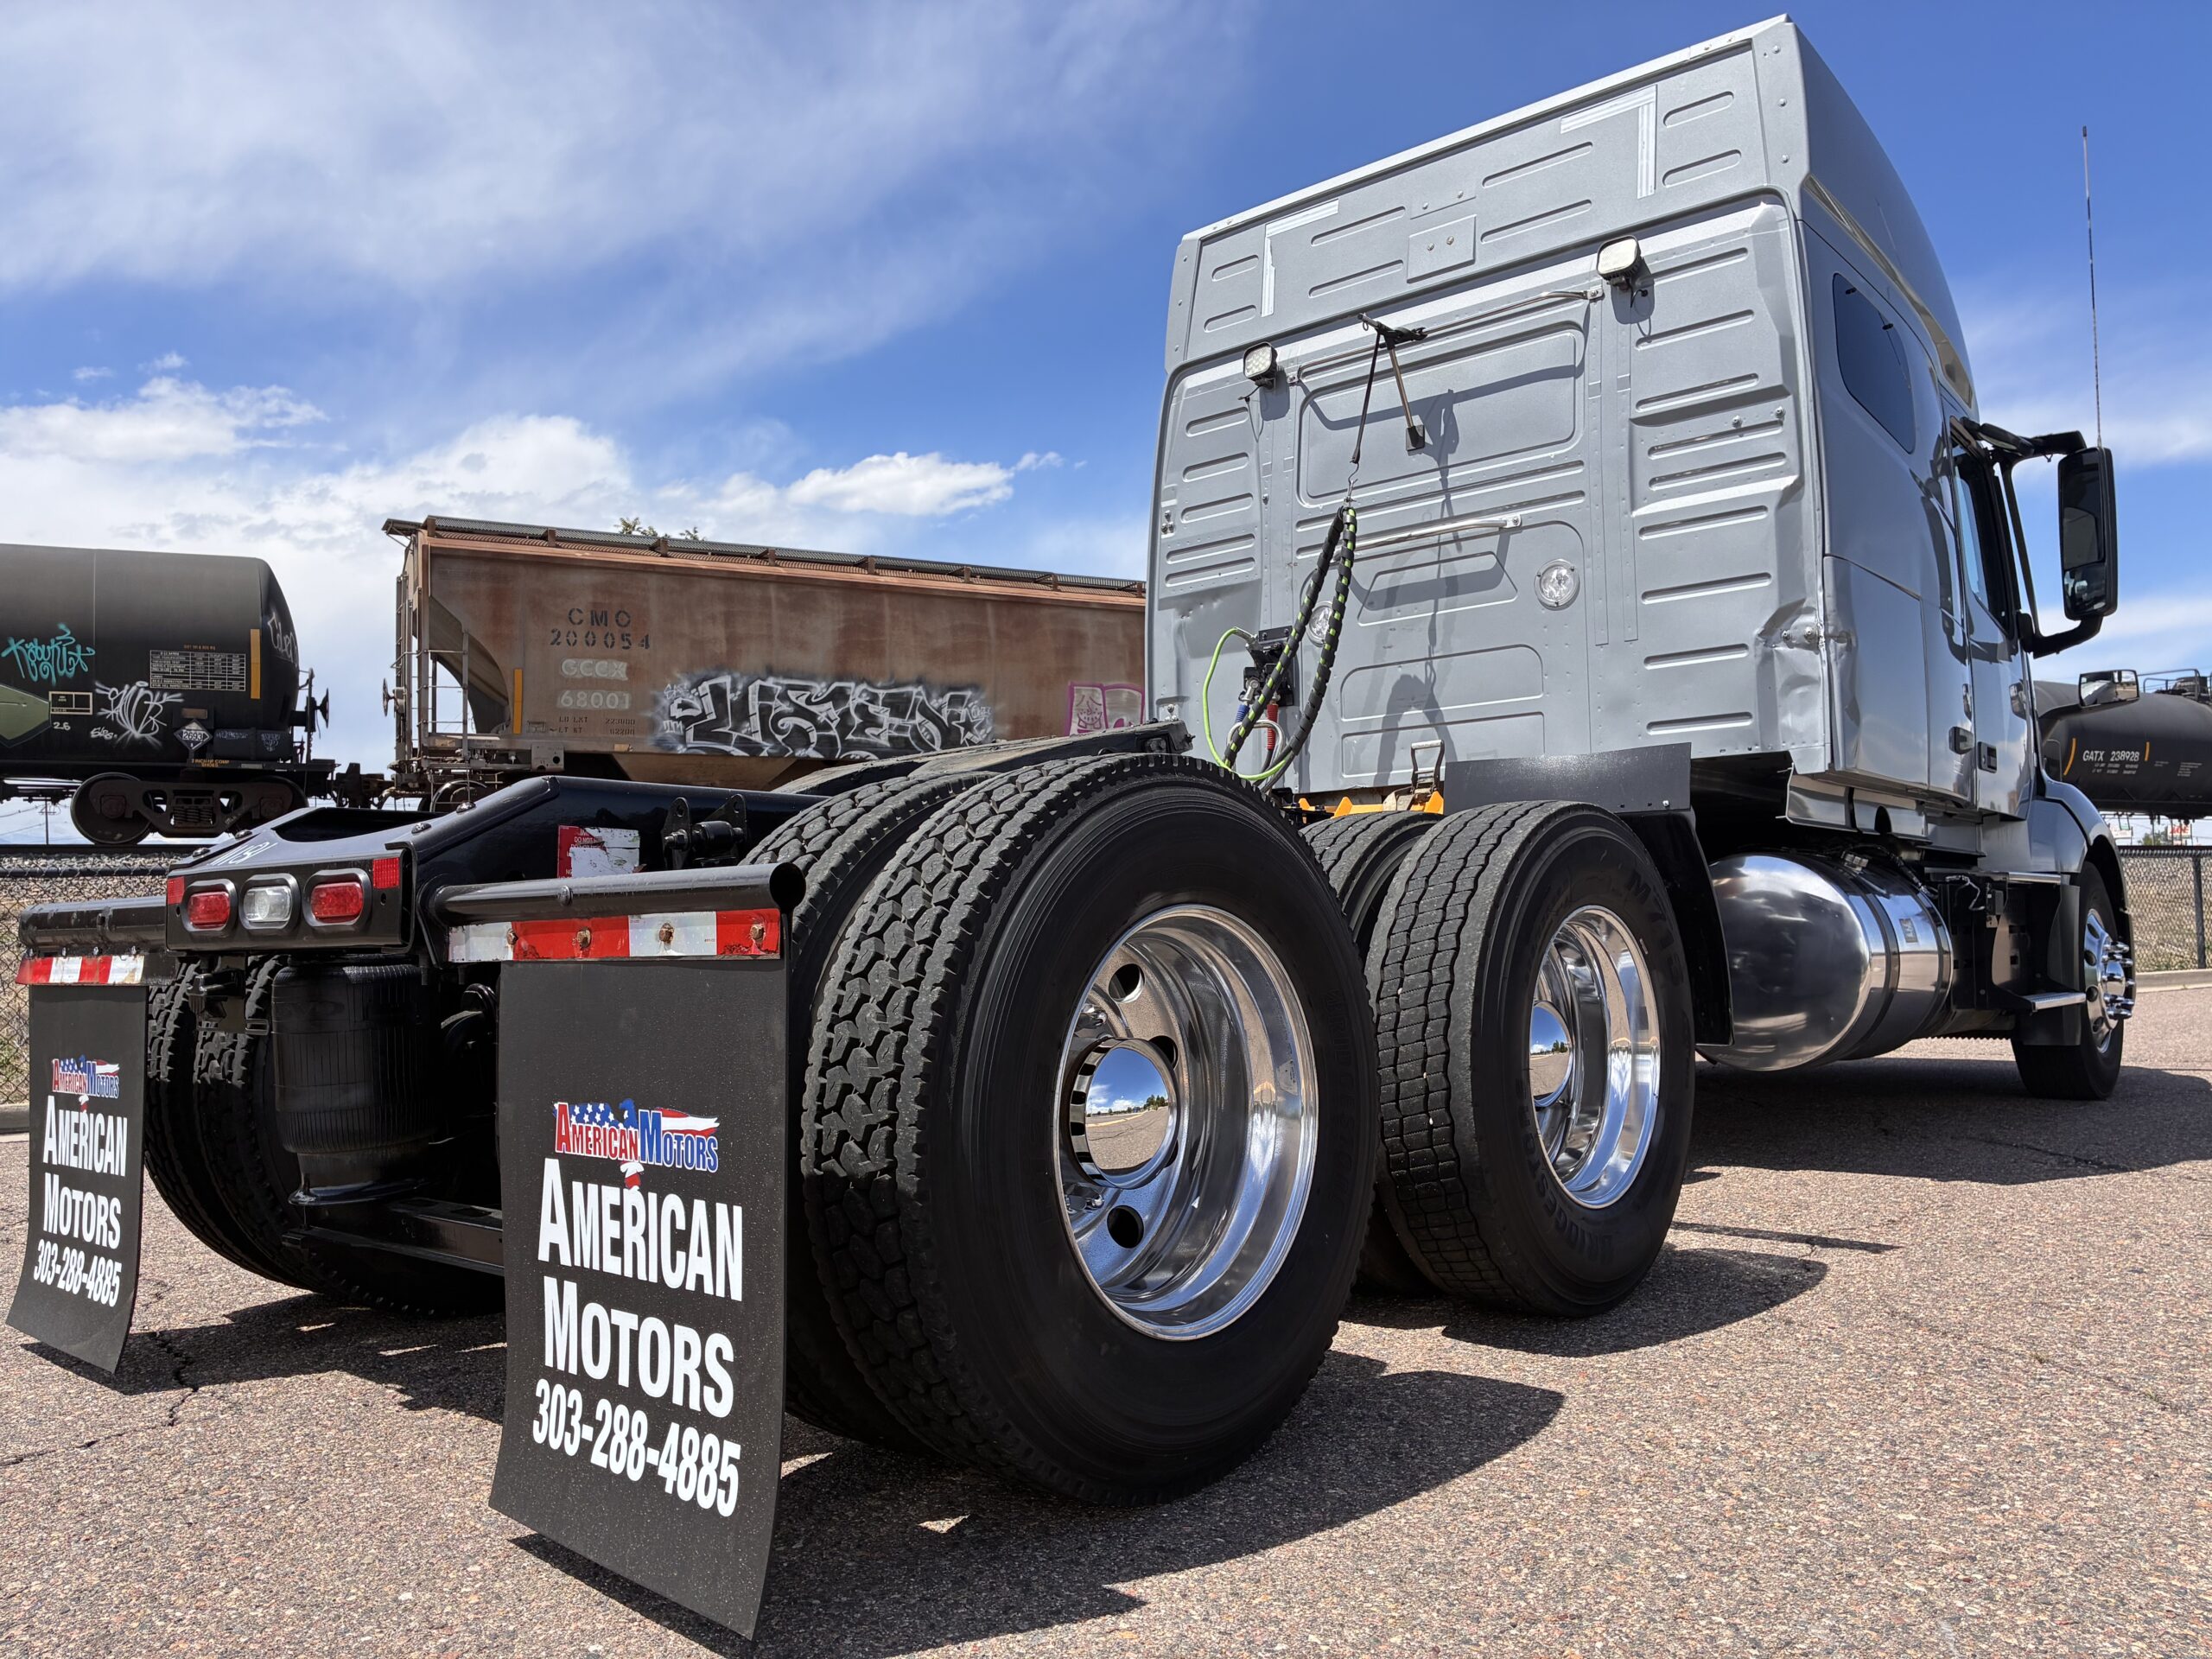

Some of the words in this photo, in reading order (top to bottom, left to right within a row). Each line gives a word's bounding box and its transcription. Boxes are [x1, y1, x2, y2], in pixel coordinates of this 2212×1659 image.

[550, 628, 651, 650] 200054
[568, 607, 632, 628] CMO
[560, 690, 630, 709] 68001
[183, 731, 203, 741] 2693
[2082, 749, 2106, 762] GATX
[2109, 751, 2140, 762] 238928
[42, 1095, 128, 1177] AMERICAN
[43, 1172, 121, 1249] MOTORS
[537, 1157, 744, 1302] AMERICAN
[33, 1238, 123, 1308] 303-288-4885
[543, 1275, 734, 1419] MOTORS
[532, 1378, 742, 1518] 303-288-4885
